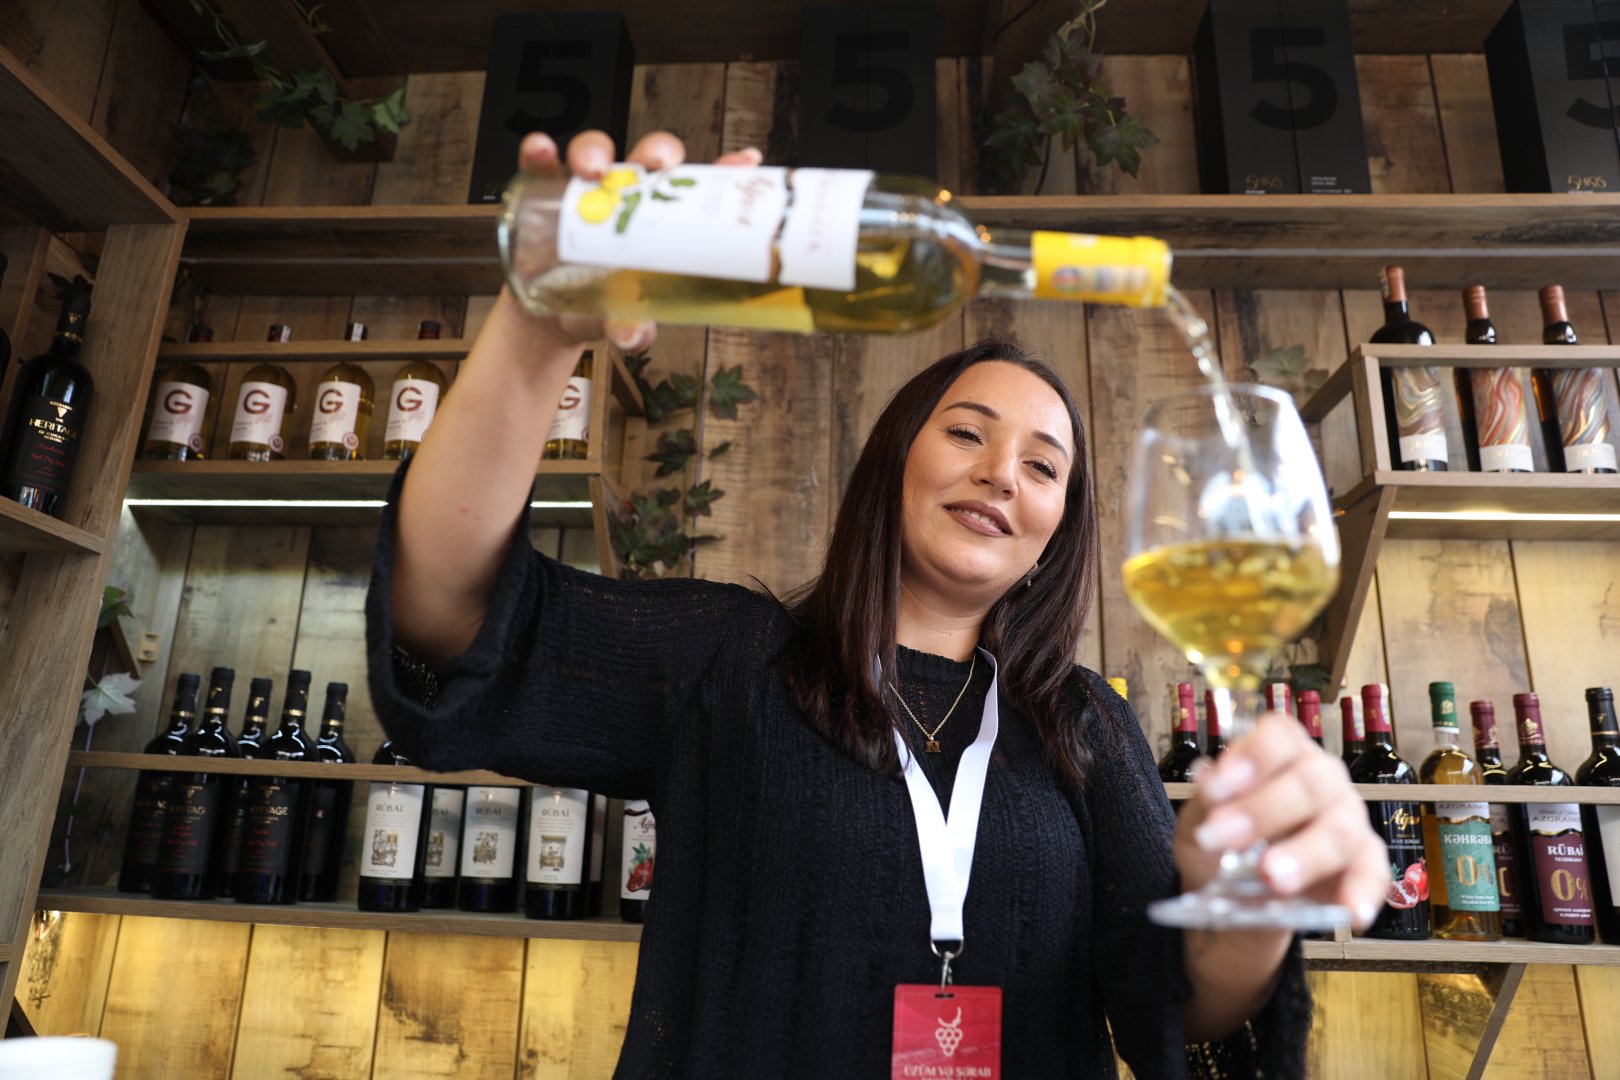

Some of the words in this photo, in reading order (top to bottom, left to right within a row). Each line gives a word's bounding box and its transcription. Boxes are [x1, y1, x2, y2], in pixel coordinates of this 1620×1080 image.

[824, 31, 915, 133] 5
[1248, 27, 1338, 131] 5
[164, 389, 193, 415] G
[243, 389, 271, 415] G
[319, 388, 344, 414] G
[396, 386, 423, 412] G
